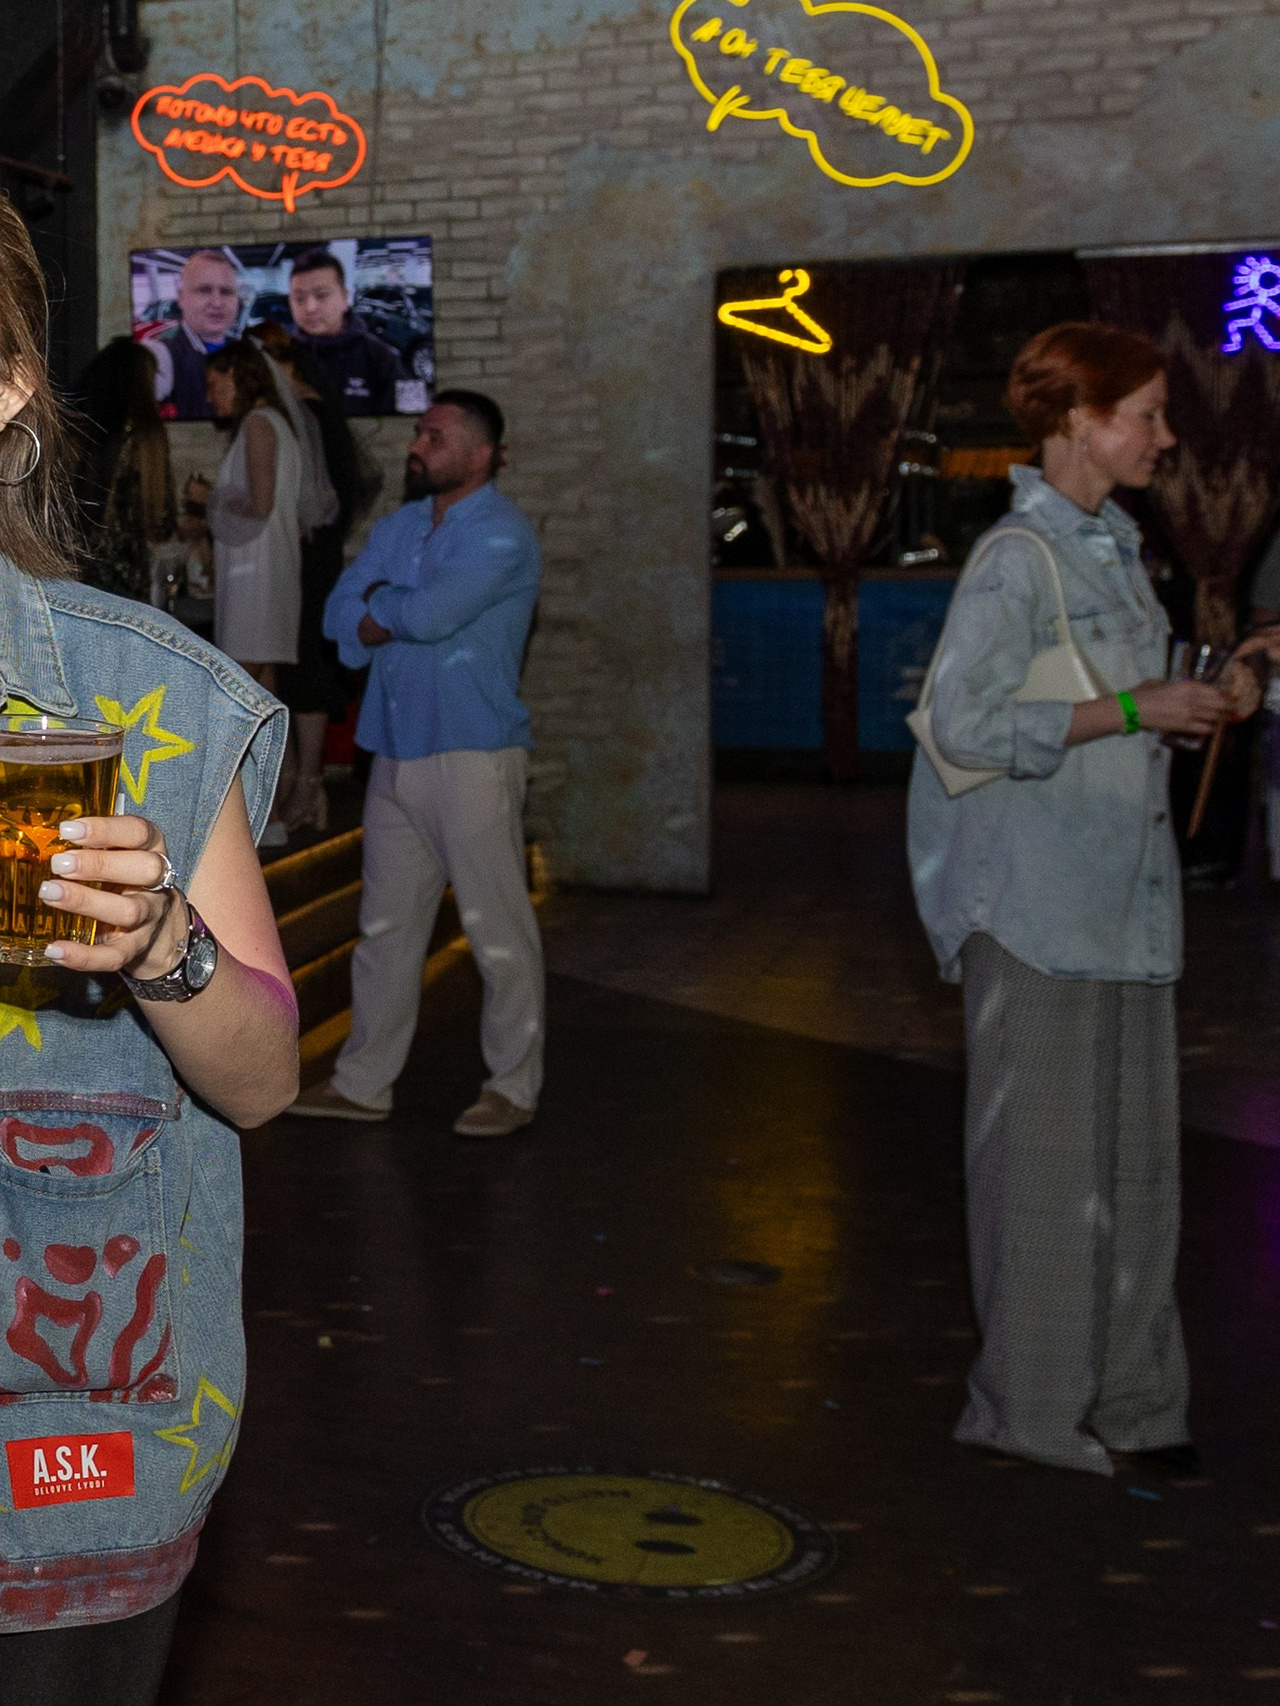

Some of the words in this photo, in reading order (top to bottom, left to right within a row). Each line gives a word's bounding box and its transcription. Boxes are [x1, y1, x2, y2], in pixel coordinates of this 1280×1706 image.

[764, 47, 847, 103] ТЕБЯ
[240, 109, 284, 135] ЧТО
[286, 117, 348, 145] ЕСТЬ
[270, 145, 333, 172] ТЕБЯ
[33, 1444, 107, 1485] A.S.K.
